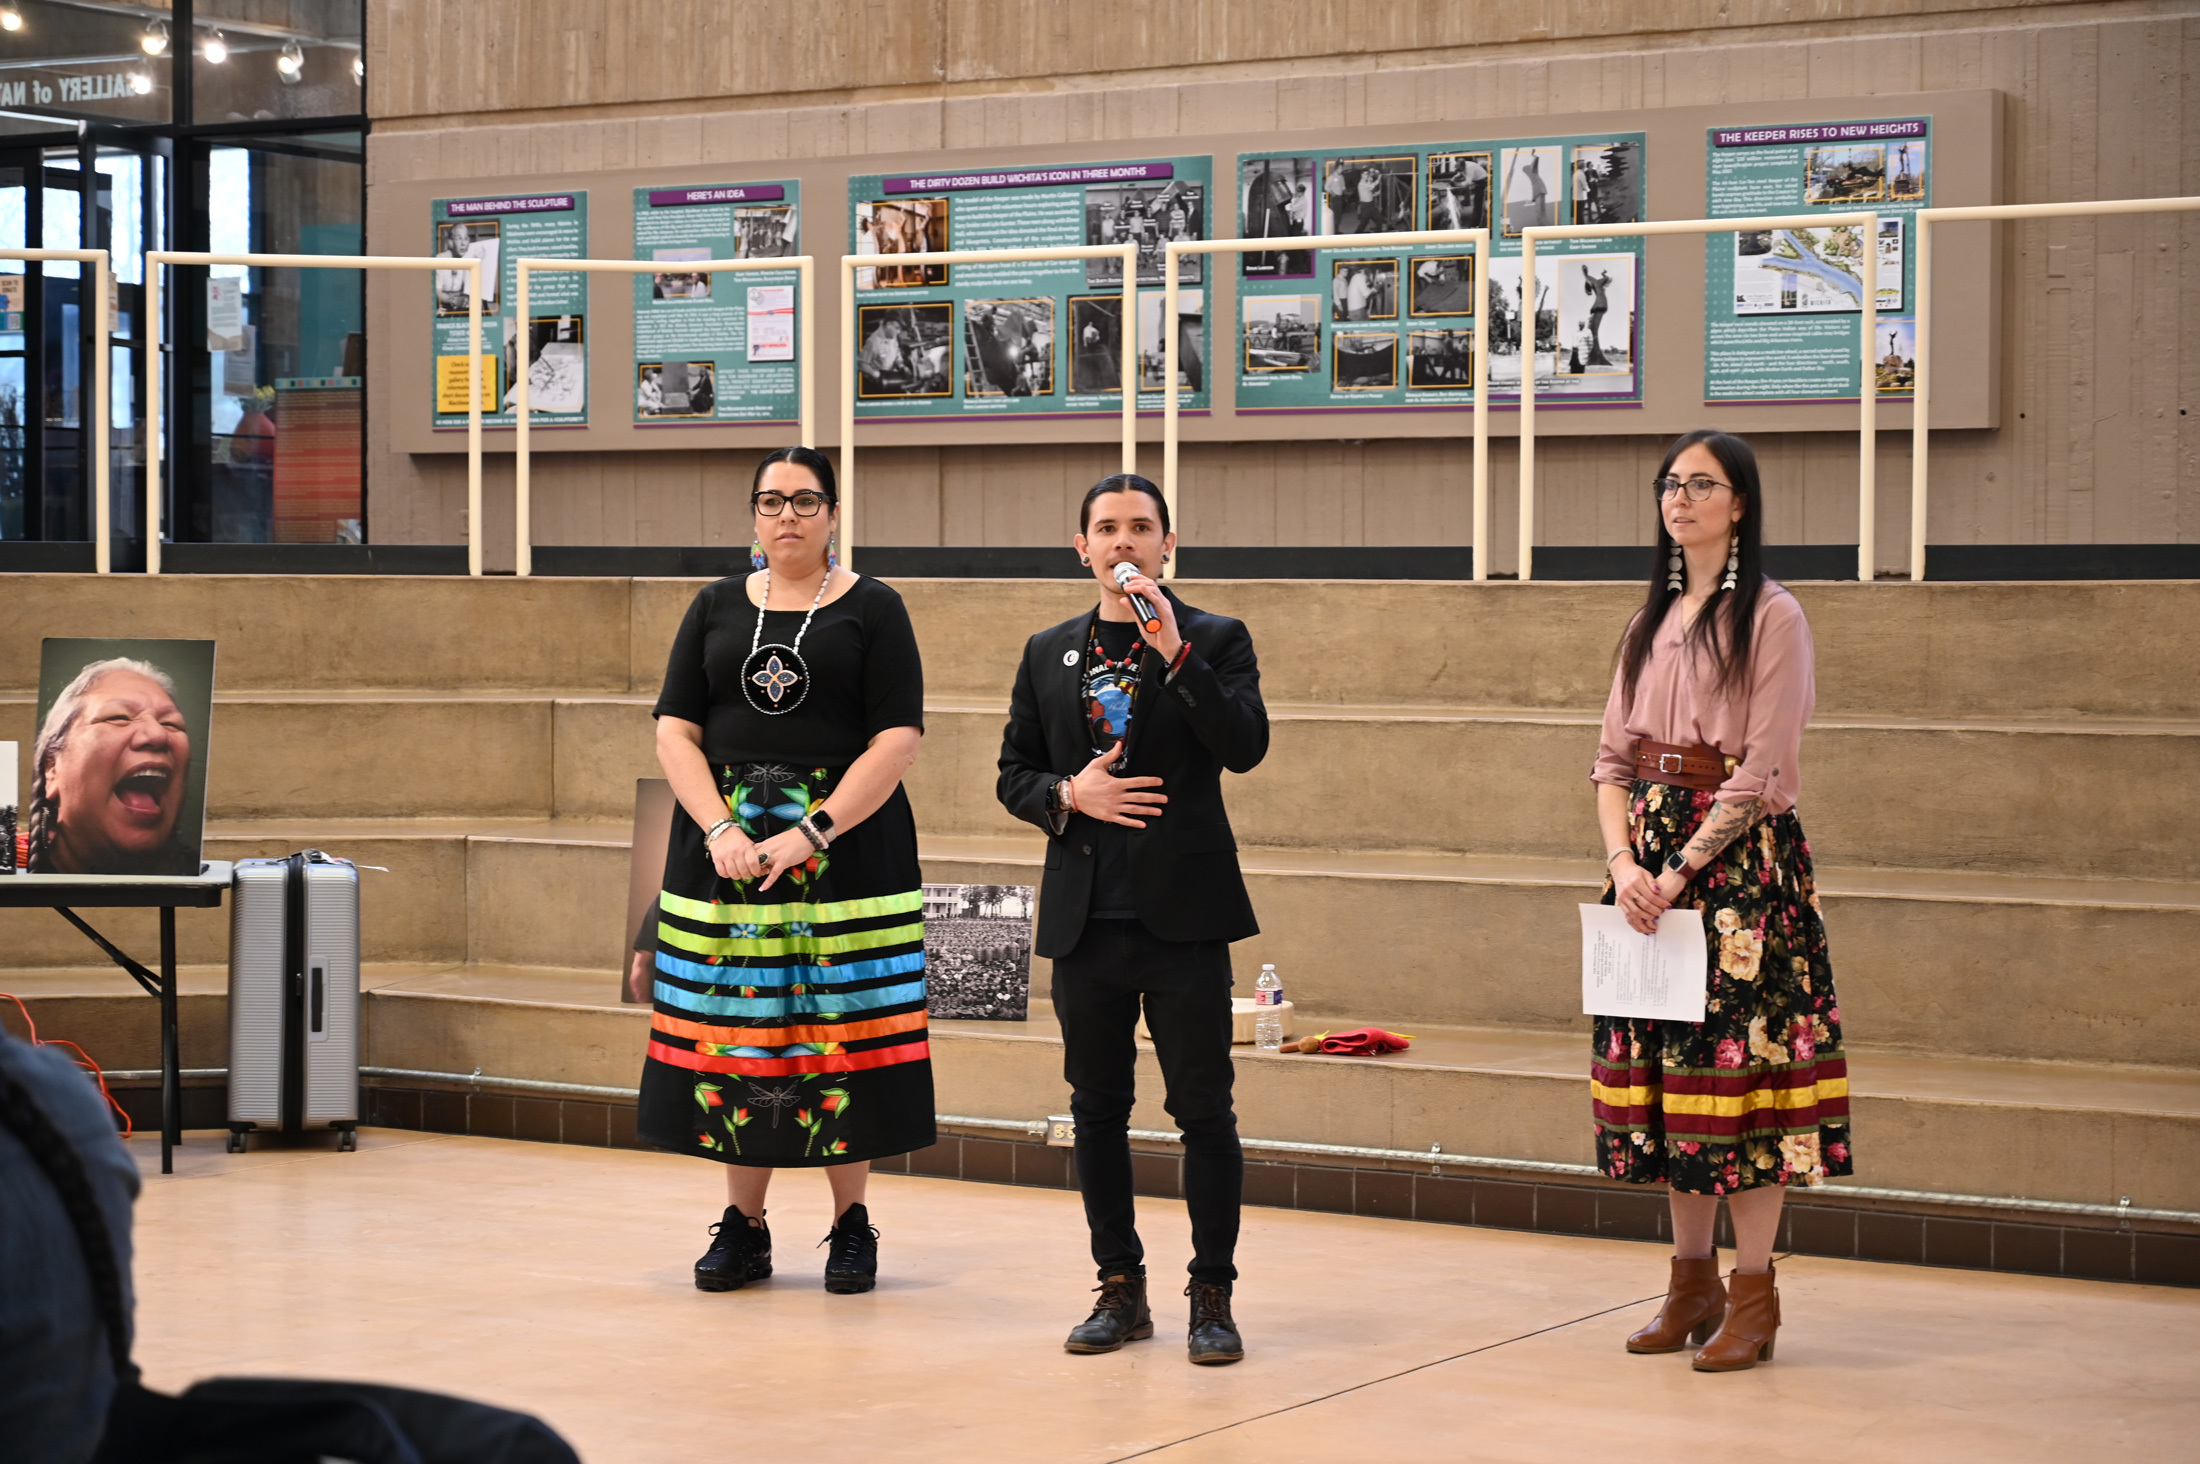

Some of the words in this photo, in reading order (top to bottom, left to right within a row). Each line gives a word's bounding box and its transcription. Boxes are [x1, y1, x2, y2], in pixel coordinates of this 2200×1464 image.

[1720, 132, 1742, 142] THE
[1744, 130, 1786, 142] KEEPER
[1789, 128, 1818, 139] RISES
[1822, 127, 1837, 137] TO
[1840, 125, 1867, 136] NEW
[1870, 123, 1918, 135] HEIGHTS
[910, 180, 926, 188] THE
[927, 178, 951, 187] DIRTY
[952, 176, 980, 186] DOZEN
[981, 175, 1006, 184] BUILD
[1049, 171, 1070, 180] ICON
[1071, 171, 1080, 179] IN
[1082, 169, 1108, 179] THREE
[1110, 167, 1146, 177] MONTHS
[686, 190, 712, 200] HERE'S
[714, 190, 725, 199] AN
[727, 189, 745, 198] IDEA
[451, 203, 465, 212] THE
[466, 203, 483, 211] MAN
[484, 201, 511, 211] BEHIND
[512, 200, 526, 209] THE
[528, 197, 568, 208] SCULPTURE
